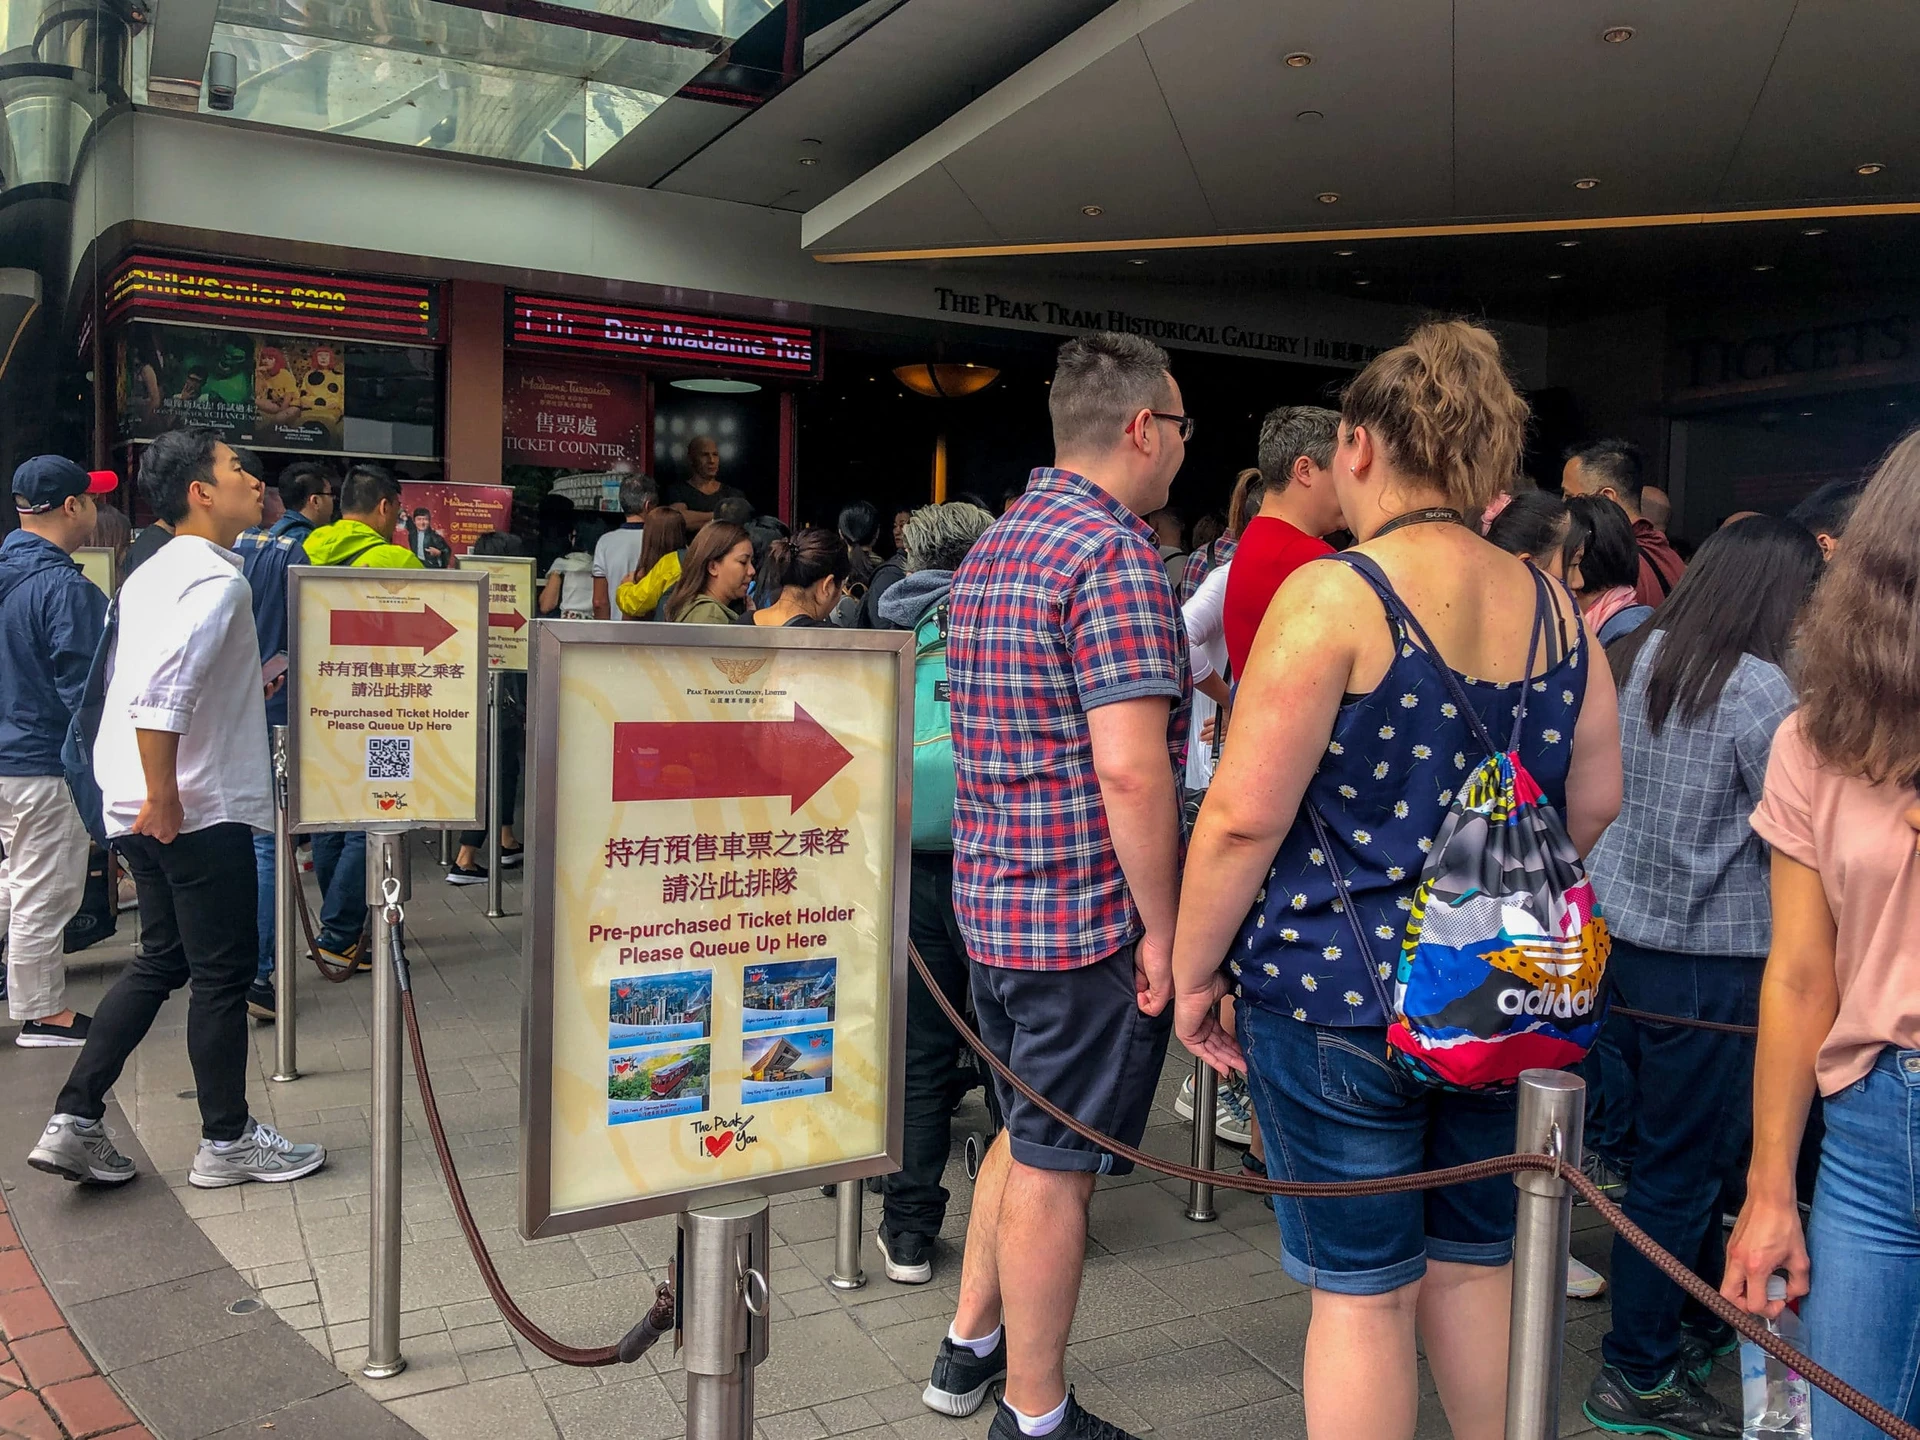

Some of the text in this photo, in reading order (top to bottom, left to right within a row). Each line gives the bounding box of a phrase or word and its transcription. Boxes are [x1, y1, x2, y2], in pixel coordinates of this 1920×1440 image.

[934, 287, 980, 314] THE
[984, 294, 1039, 322] PEAK
[1043, 301, 1102, 330] TRAM
[1107, 310, 1219, 345] HISTORICAL
[1221, 325, 1300, 354] GALLERY
[662, 324, 766, 356] Madame
[520, 375, 612, 397] Madame Tussauds
[535, 411, 598, 437] 售票處
[503, 436, 626, 457] TICKET COUNTER
[1420, 510, 1447, 519] SONY
[317, 661, 466, 679] 持有預售車票之乘客
[350, 682, 433, 698] 請沿此排隊
[309, 707, 470, 719] Pre-purchased Ticket Holder
[327, 720, 452, 732] Please Queue Up Here
[604, 826, 850, 869] 持有預售車票之乘客
[661, 866, 799, 904] 請沿此排隊
[588, 906, 856, 943] Pre-purchased Ticket Holder
[618, 932, 828, 966] Please Queue Up Here
[690, 1112, 743, 1134] The Peak
[735, 1130, 758, 1152] You
